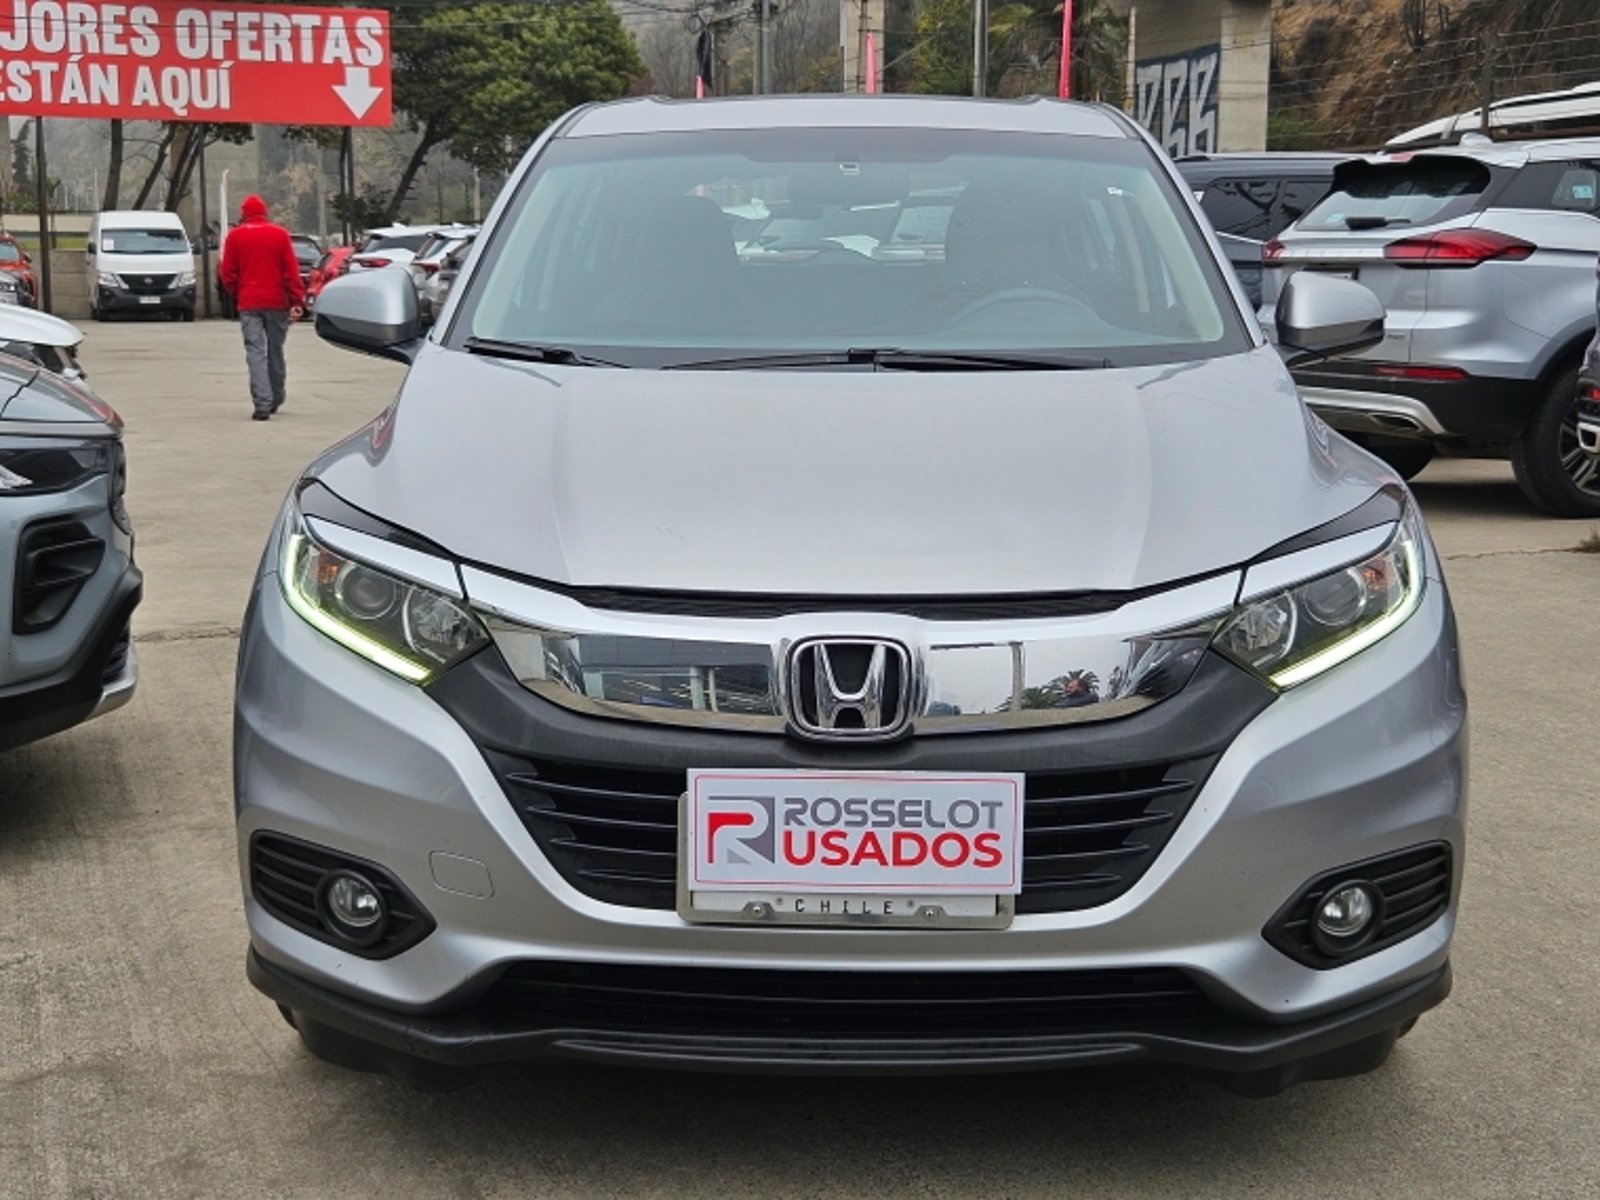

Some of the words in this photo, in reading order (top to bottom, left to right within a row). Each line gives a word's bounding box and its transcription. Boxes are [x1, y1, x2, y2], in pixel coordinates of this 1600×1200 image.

[176, 9, 384, 66] OFERTAS
[0, 54, 119, 106] STÁN
[132, 60, 235, 117] AQUÍ
[784, 797, 1003, 829] ROSSELOT
[783, 830, 1003, 868] USADOS
[795, 899, 893, 914] CHILE
